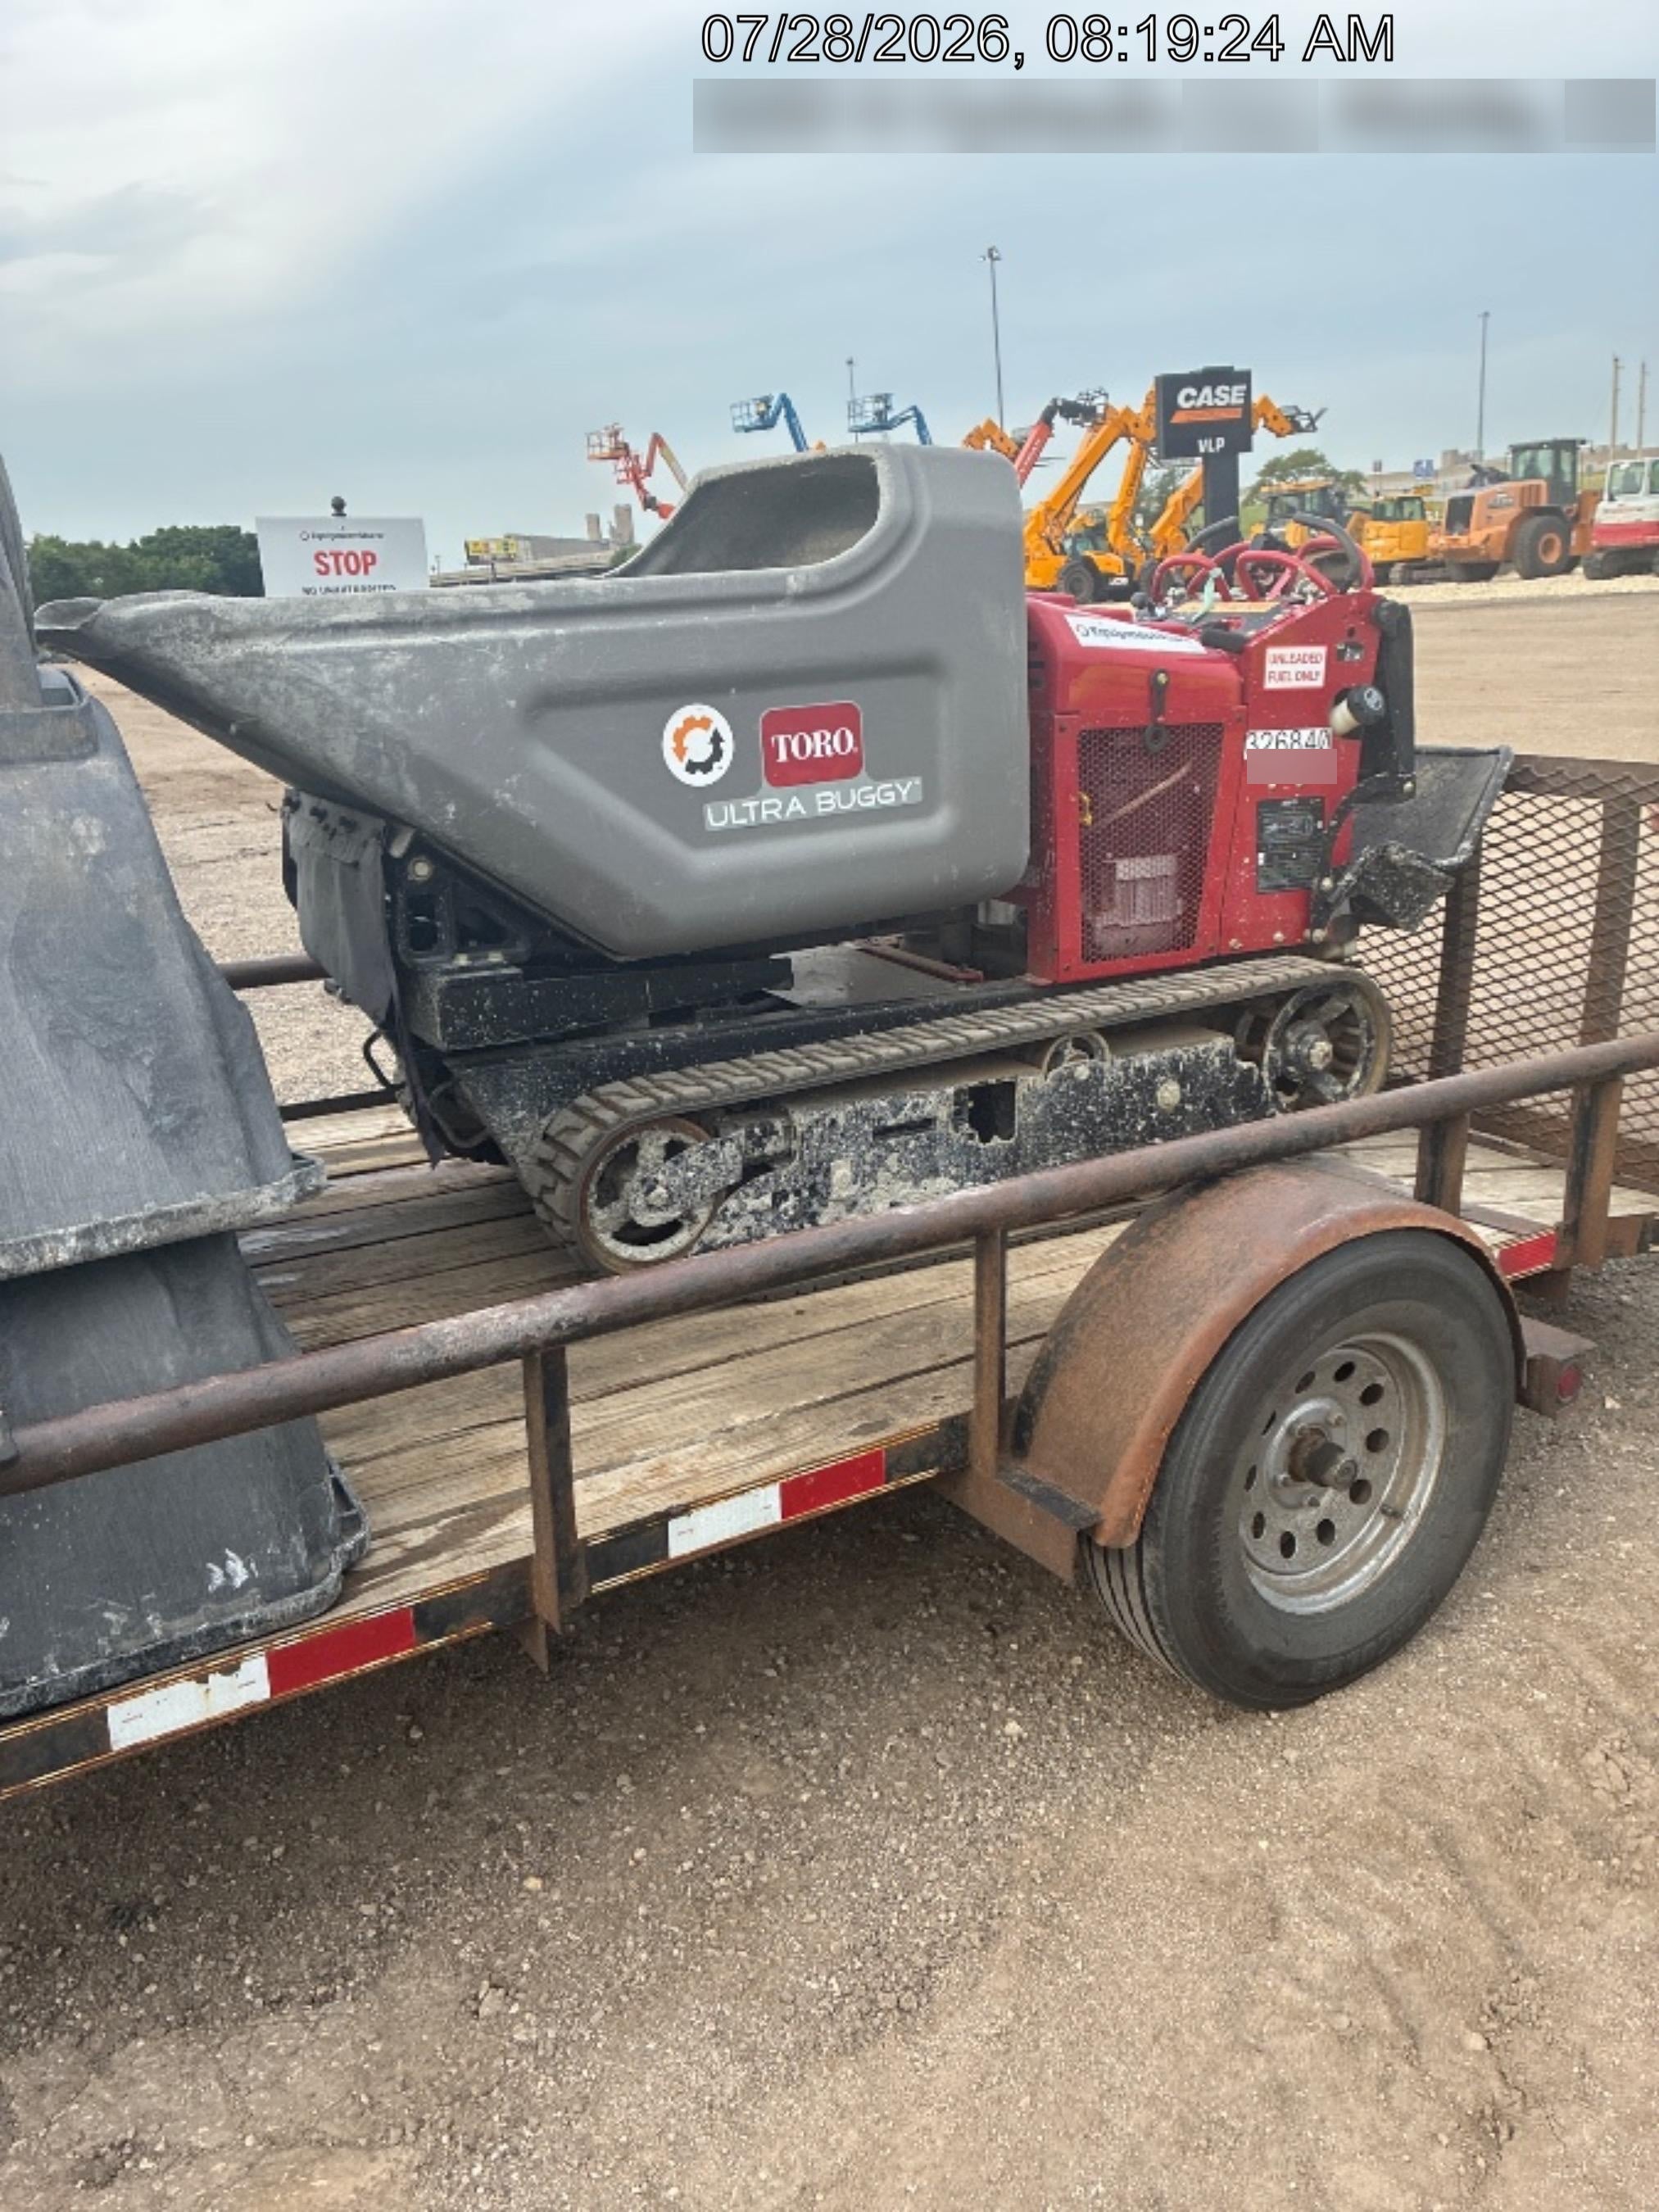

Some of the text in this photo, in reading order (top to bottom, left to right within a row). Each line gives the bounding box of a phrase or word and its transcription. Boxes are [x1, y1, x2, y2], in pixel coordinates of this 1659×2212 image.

[1177, 384, 1247, 408] CASE
[1197, 437, 1225, 452] VLP
[314, 550, 377, 575] STOP
[1268, 651, 1323, 664] UNLEADED
[1268, 670, 1321, 683] FUEL ONLY
[772, 728, 854, 763] TORO
[707, 781, 913, 827] ULTRA BUGGY
